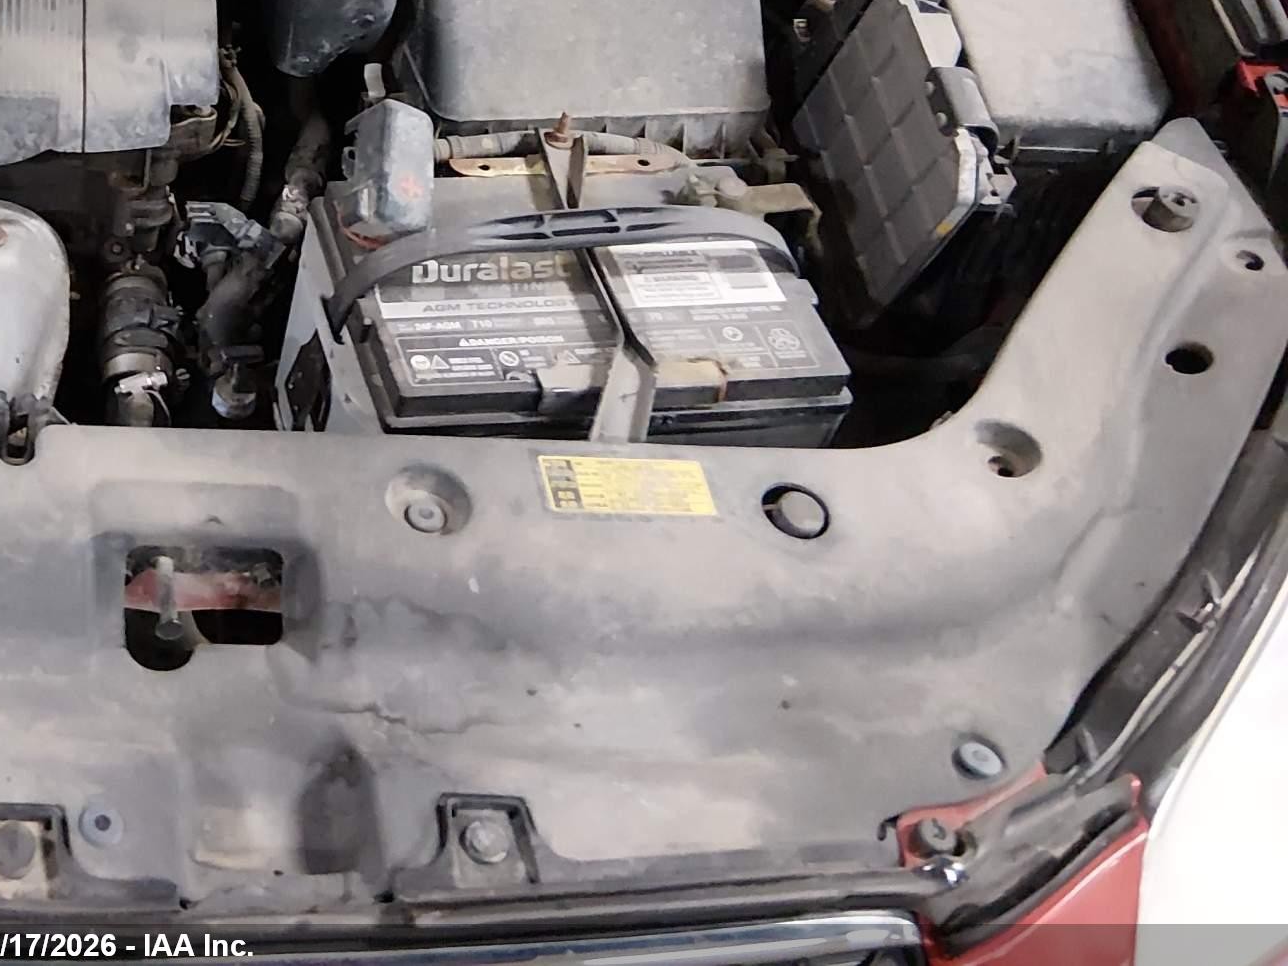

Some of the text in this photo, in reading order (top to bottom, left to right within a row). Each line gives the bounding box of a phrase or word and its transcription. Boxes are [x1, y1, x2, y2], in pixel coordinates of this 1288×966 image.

[411, 254, 572, 284] Duralast
[423, 298, 578, 313] AGM TECHNOLOGY
